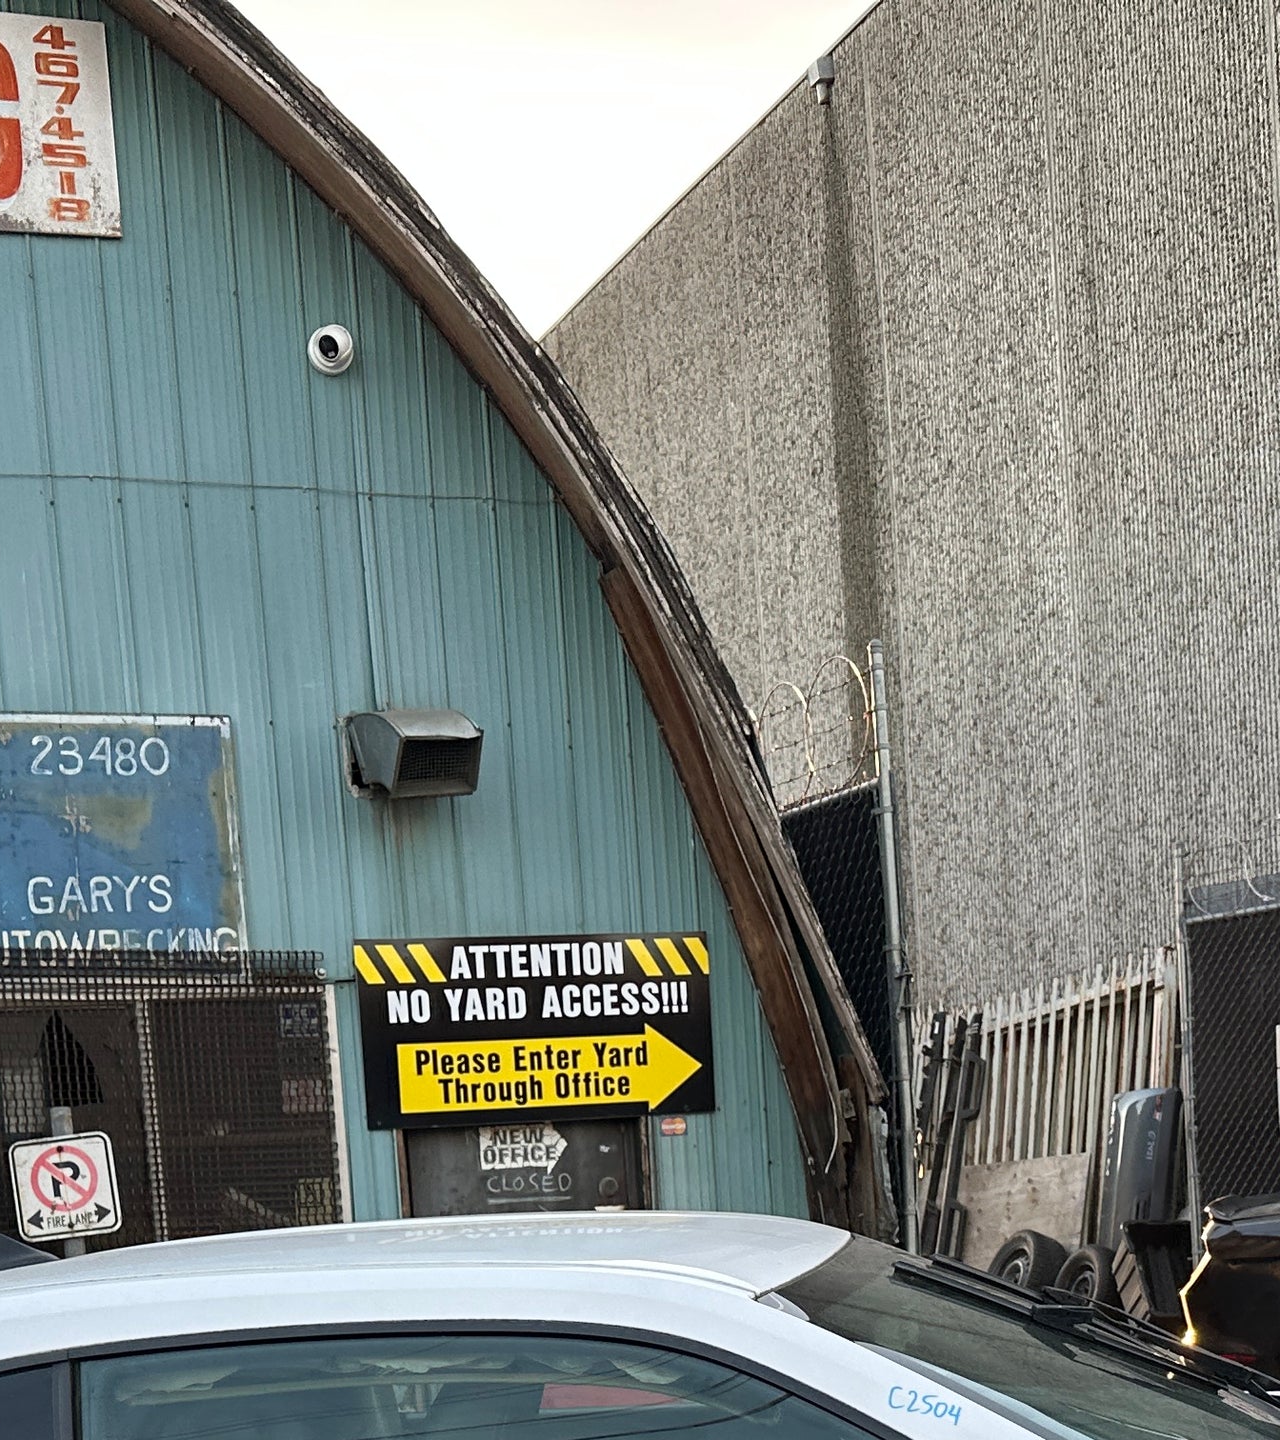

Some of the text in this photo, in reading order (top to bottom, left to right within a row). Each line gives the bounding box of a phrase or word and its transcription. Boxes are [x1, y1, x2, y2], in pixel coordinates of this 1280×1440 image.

[30, 734, 171, 777] 23480
[27, 874, 173, 916] GARY'S
[450, 940, 624, 980] ATTENTION
[386, 980, 689, 1024] NO YARD ACCESS!!!
[414, 1040, 648, 1076] Please Enter Yard
[438, 1072, 631, 1106] Through Office
[483, 1145, 558, 1165] OFFICE
[492, 1127, 543, 1146] NEW
[46, 1215, 66, 1229] FIRE
[888, 1385, 962, 1426] C2504
